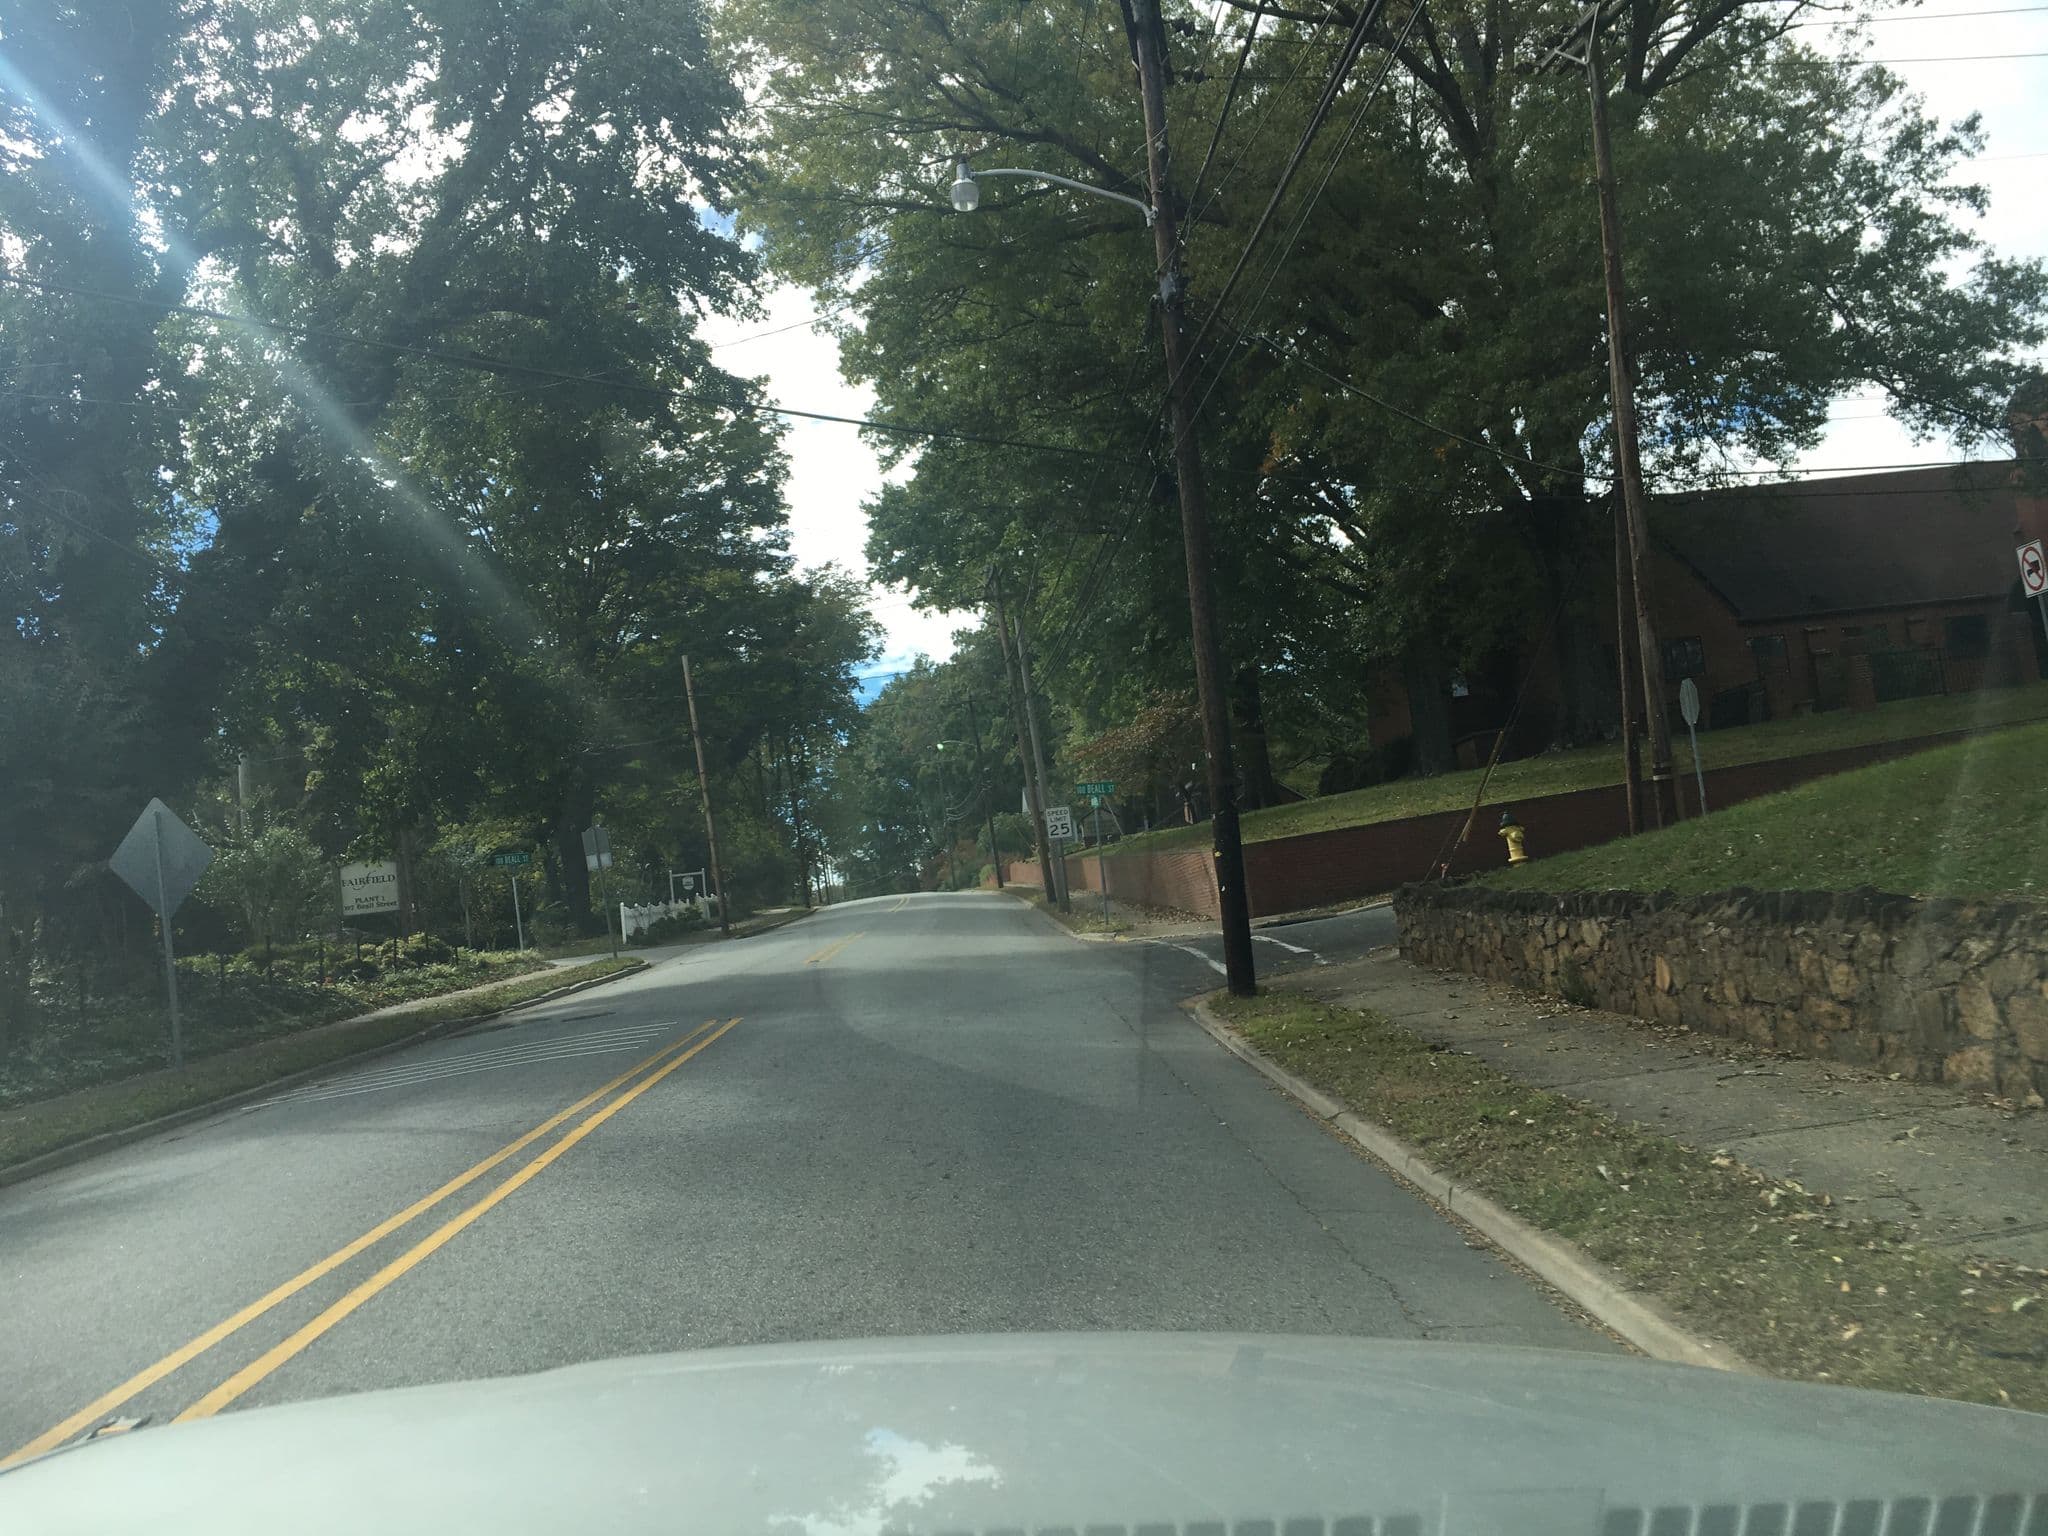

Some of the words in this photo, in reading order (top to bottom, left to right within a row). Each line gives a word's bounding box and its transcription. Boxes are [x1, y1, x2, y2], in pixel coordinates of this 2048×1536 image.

[1087, 784, 1105, 794] BEALL
[1047, 809, 1068, 817] SPEED
[1050, 823, 1070, 836] 25
[341, 871, 396, 890] FAIRFIELD
